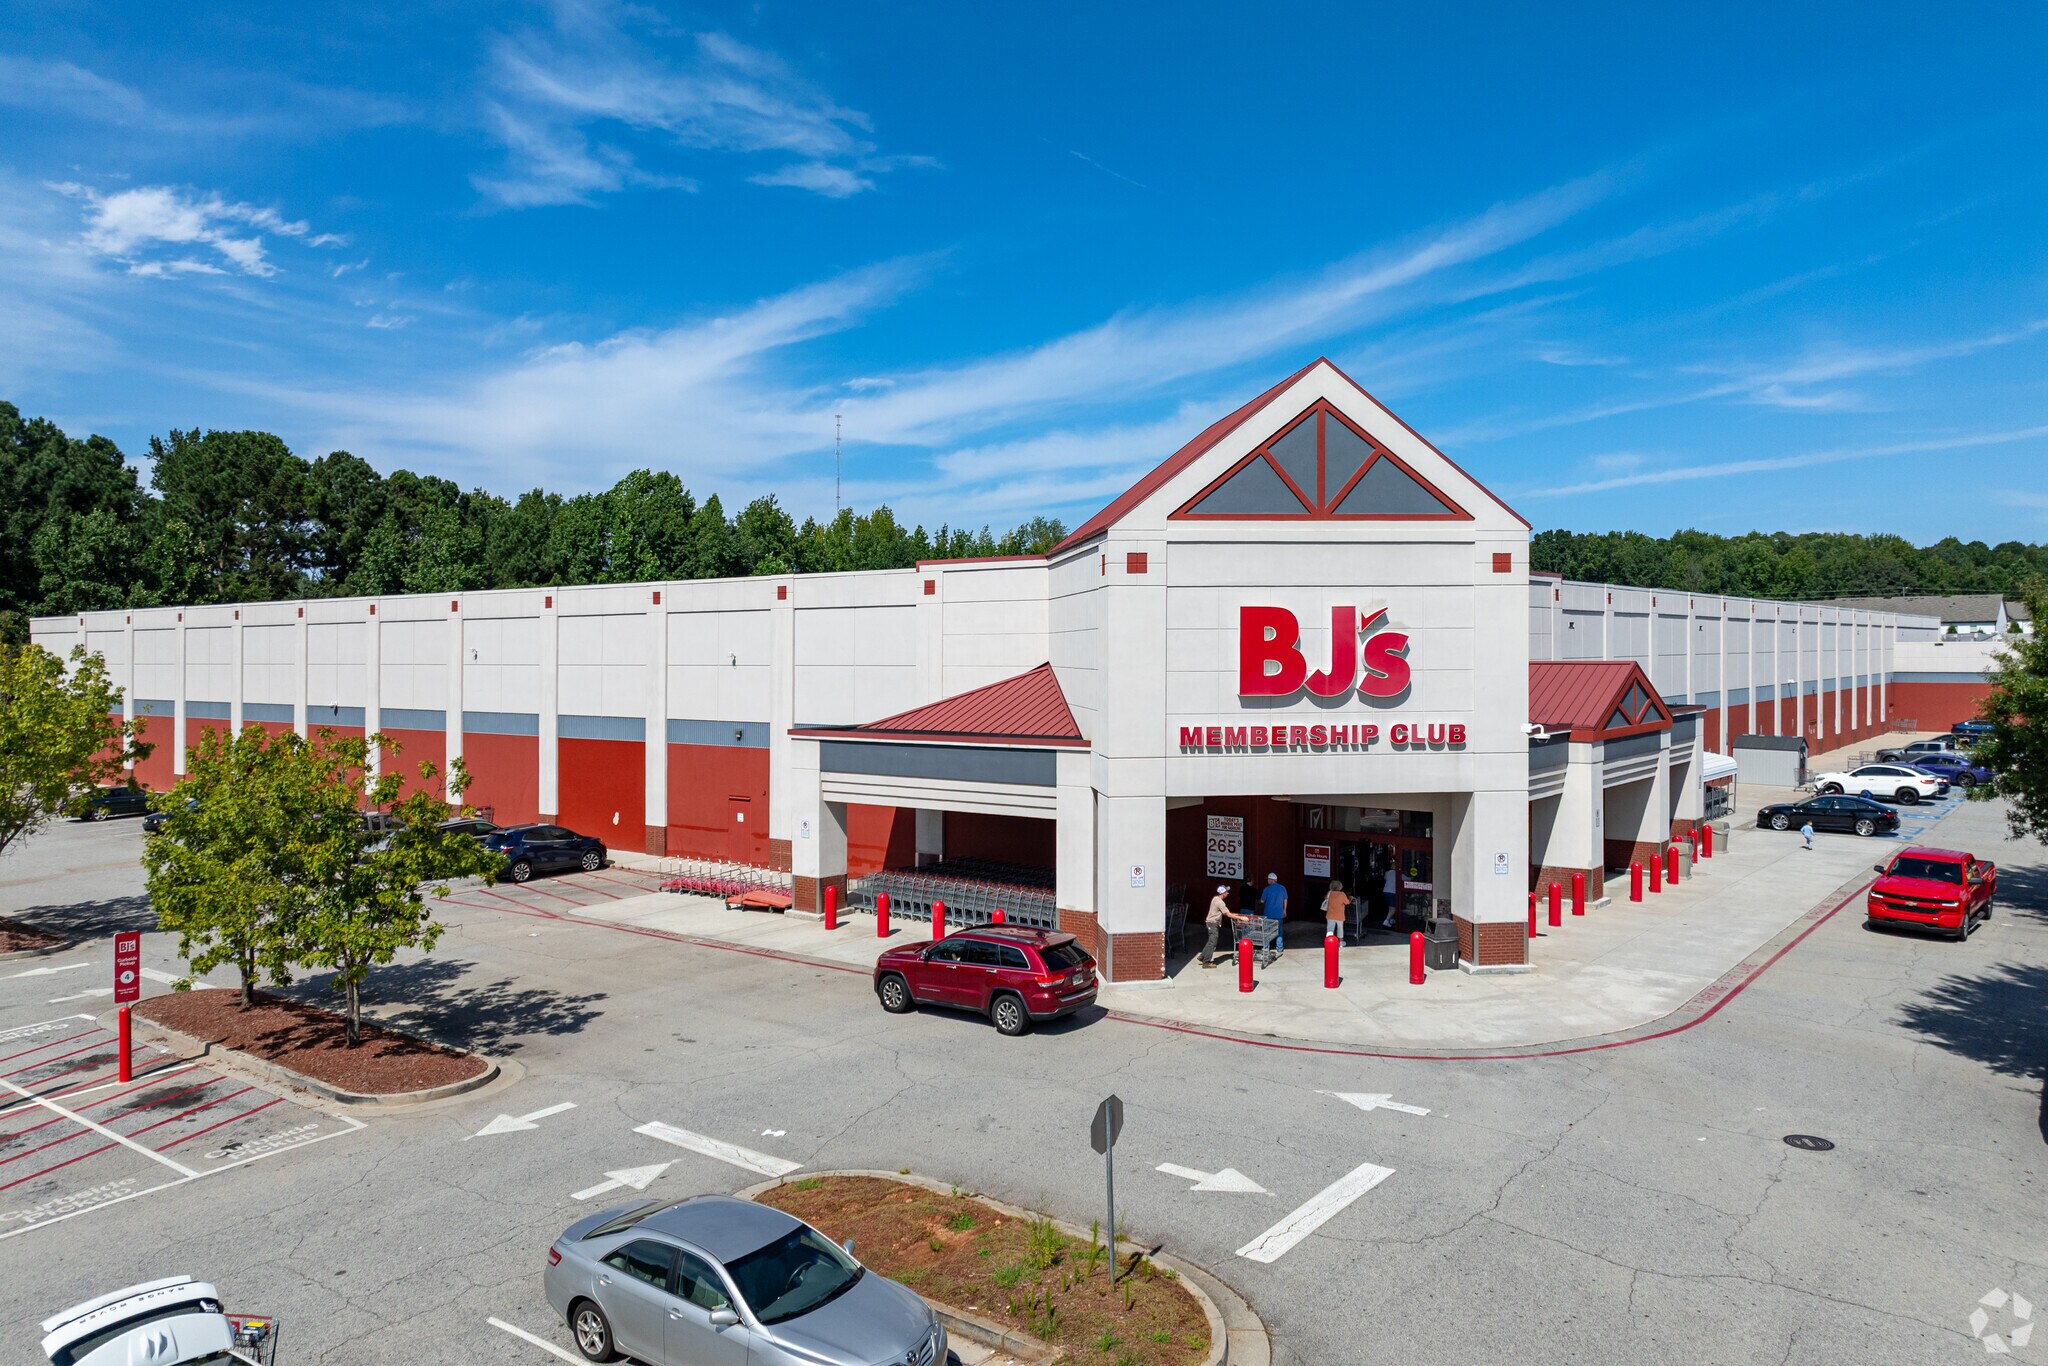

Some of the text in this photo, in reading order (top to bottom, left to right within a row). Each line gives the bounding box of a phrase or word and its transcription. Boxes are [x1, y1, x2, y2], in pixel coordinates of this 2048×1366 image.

[1239, 605, 1411, 698] BJ's
[1179, 723, 1467, 748] MEMBERSHIP CLUB
